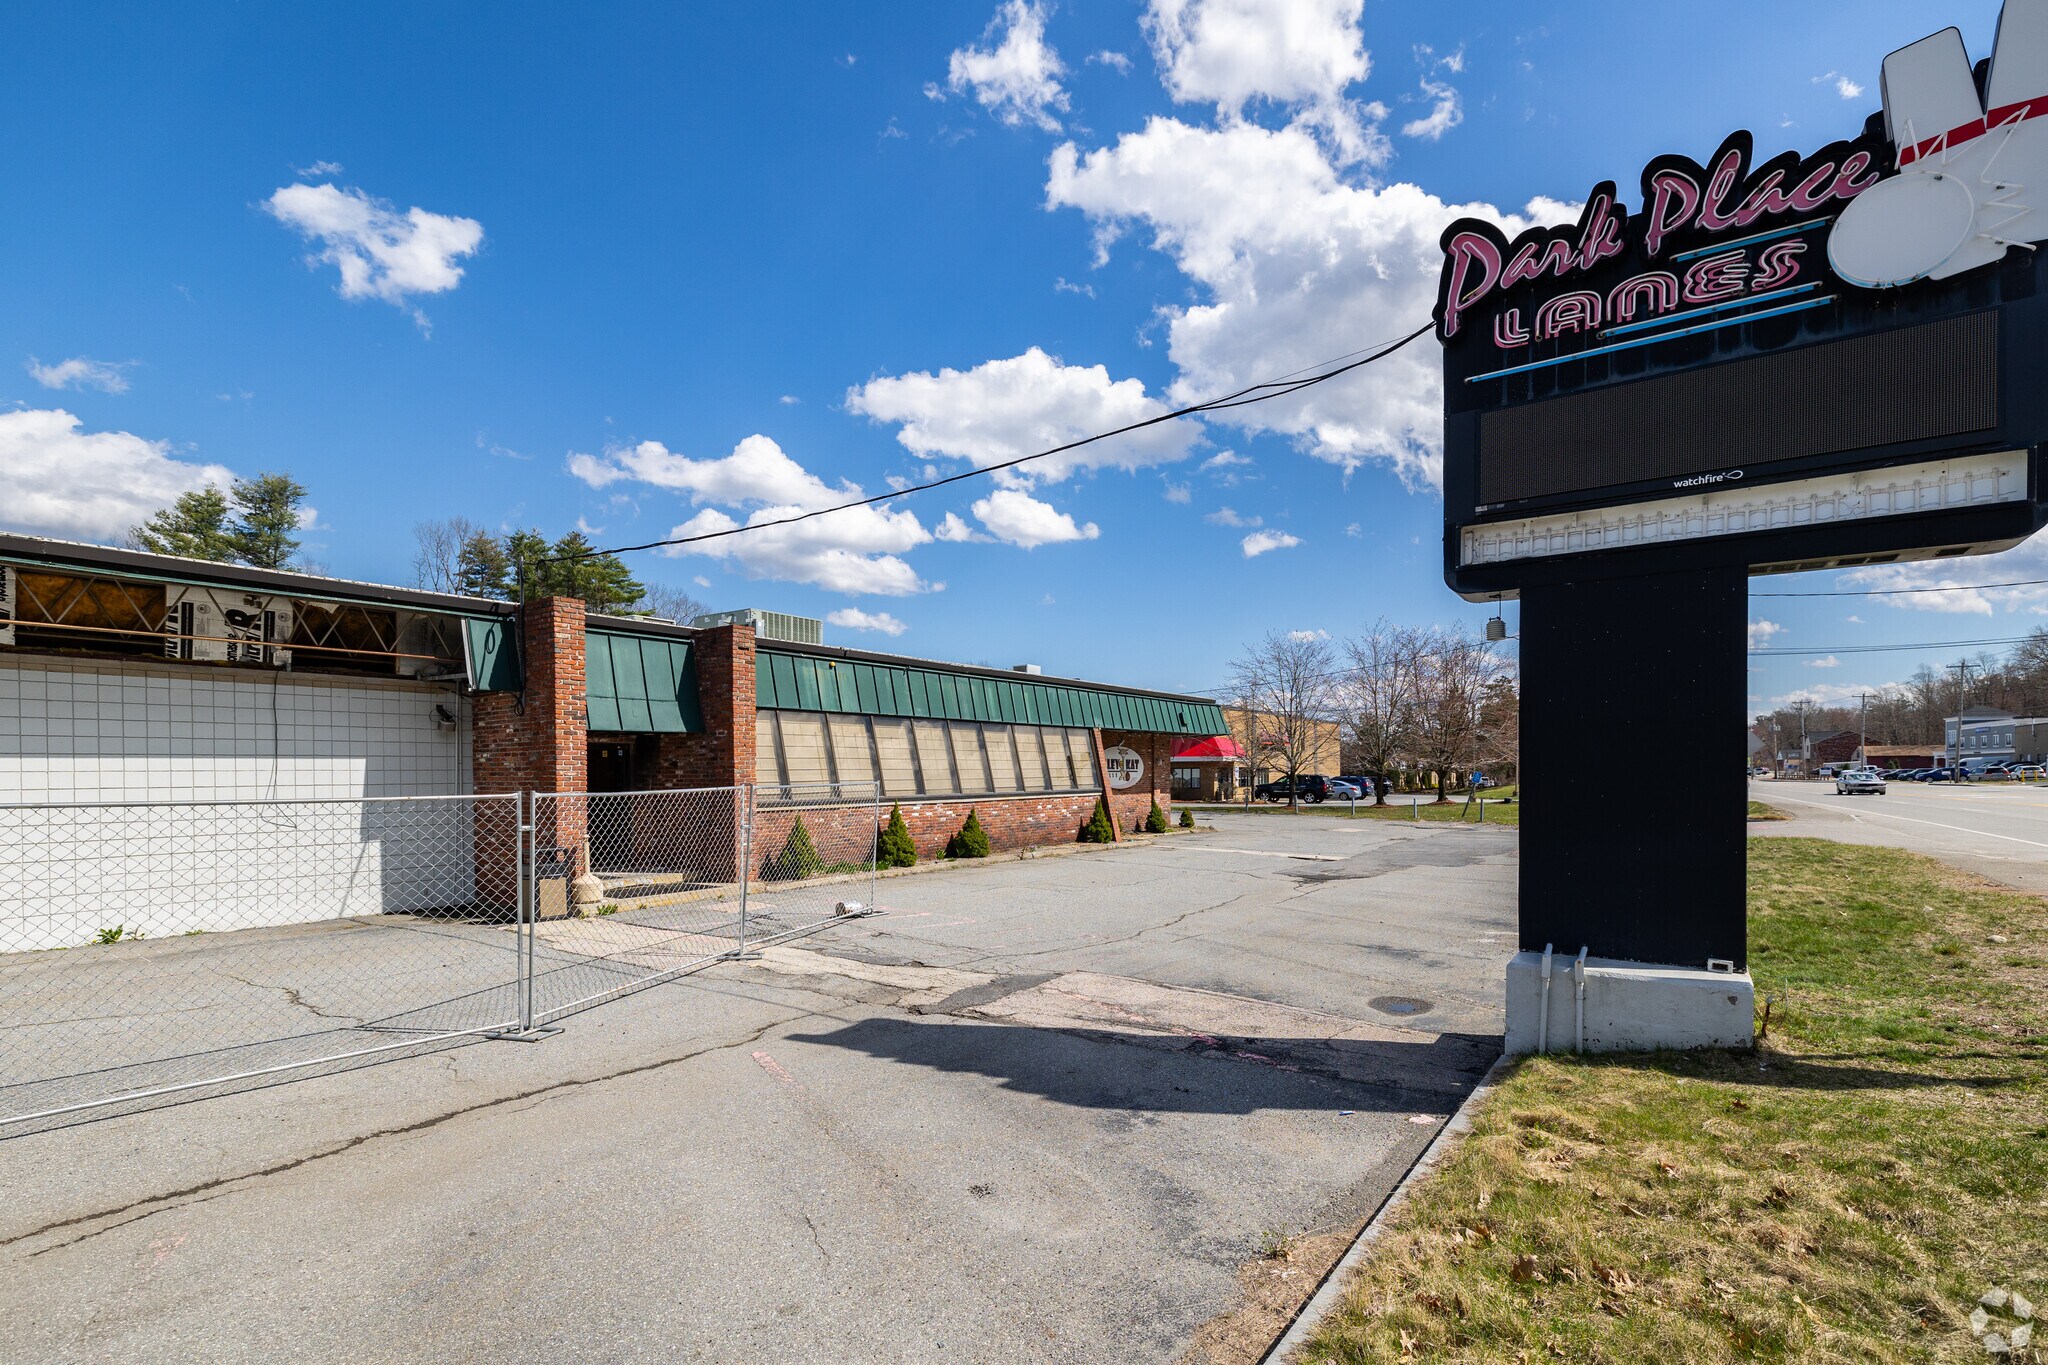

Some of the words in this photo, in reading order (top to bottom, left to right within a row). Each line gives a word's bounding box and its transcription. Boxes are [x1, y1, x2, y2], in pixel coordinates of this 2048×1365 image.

[1444, 194, 1625, 338] Park
[1644, 149, 1880, 256] Place
[1493, 238, 1808, 349] LANES
[1673, 474, 1724, 488] watchfire
[1107, 759, 1120, 769] LEY
[1126, 759, 1139, 769] KAT
